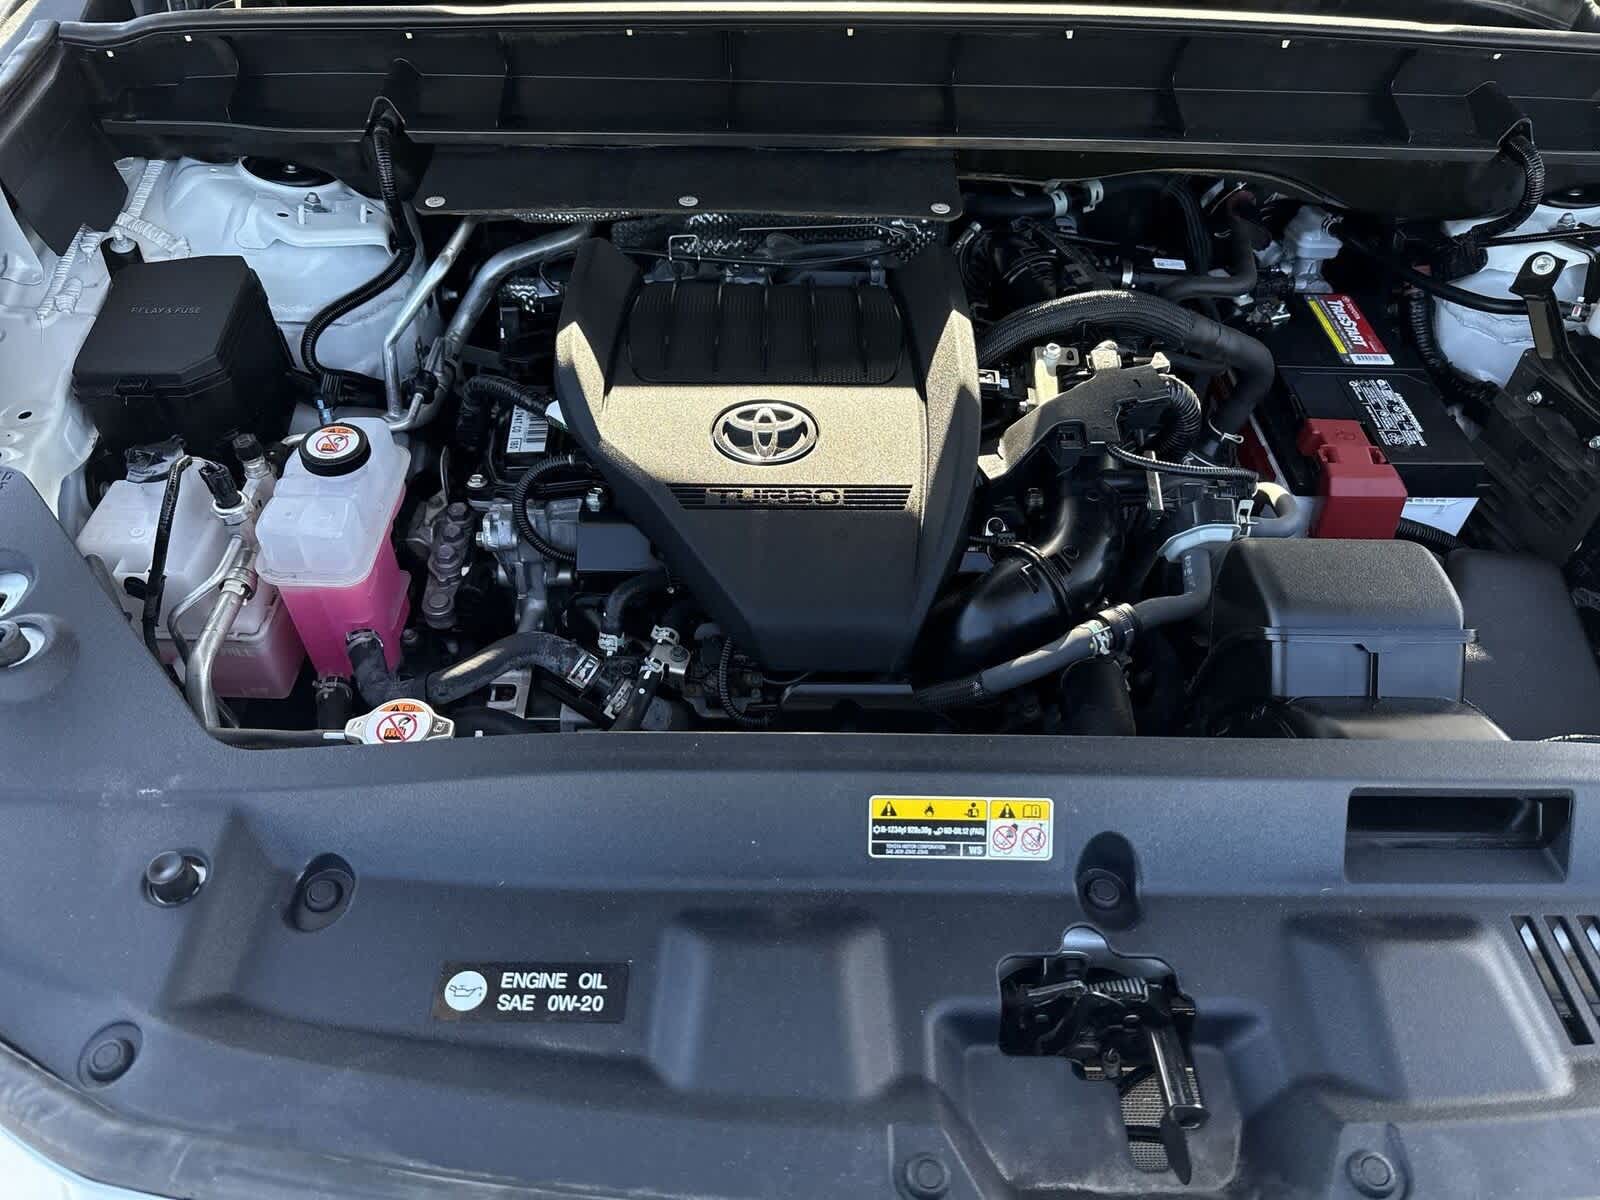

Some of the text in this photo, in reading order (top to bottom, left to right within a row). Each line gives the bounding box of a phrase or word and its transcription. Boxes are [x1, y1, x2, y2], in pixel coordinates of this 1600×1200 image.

[705, 487, 845, 505] TURBO
[500, 972, 608, 990] ENGINE OIL
[497, 994, 604, 1012] SAE 0W-20
